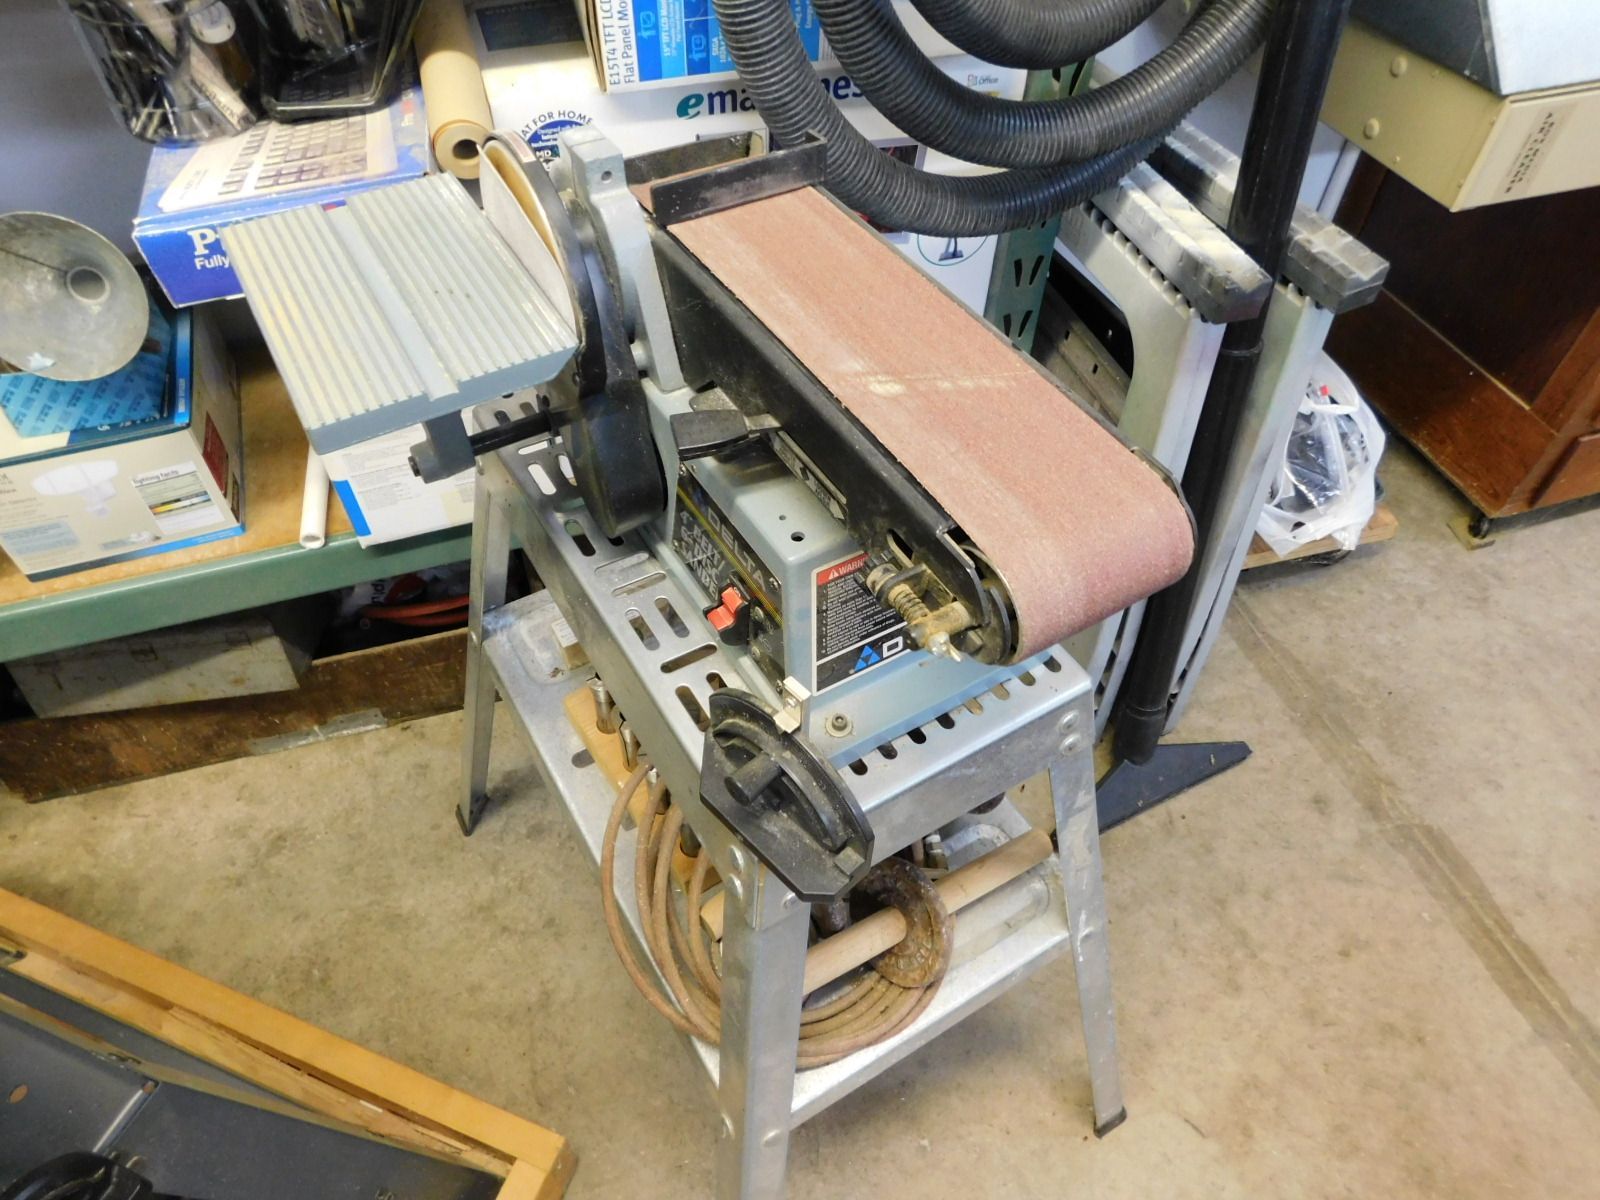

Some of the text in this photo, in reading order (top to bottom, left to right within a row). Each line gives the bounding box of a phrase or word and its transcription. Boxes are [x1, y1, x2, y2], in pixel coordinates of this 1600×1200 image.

[602, 24, 616, 45] TFT
[618, 25, 633, 59] Panel
[607, 48, 621, 85] E15T4
[623, 61, 635, 84] Flat
[532, 111, 554, 127] FOR
[194, 254, 230, 270] Fully
[708, 506, 767, 592] DELTA
